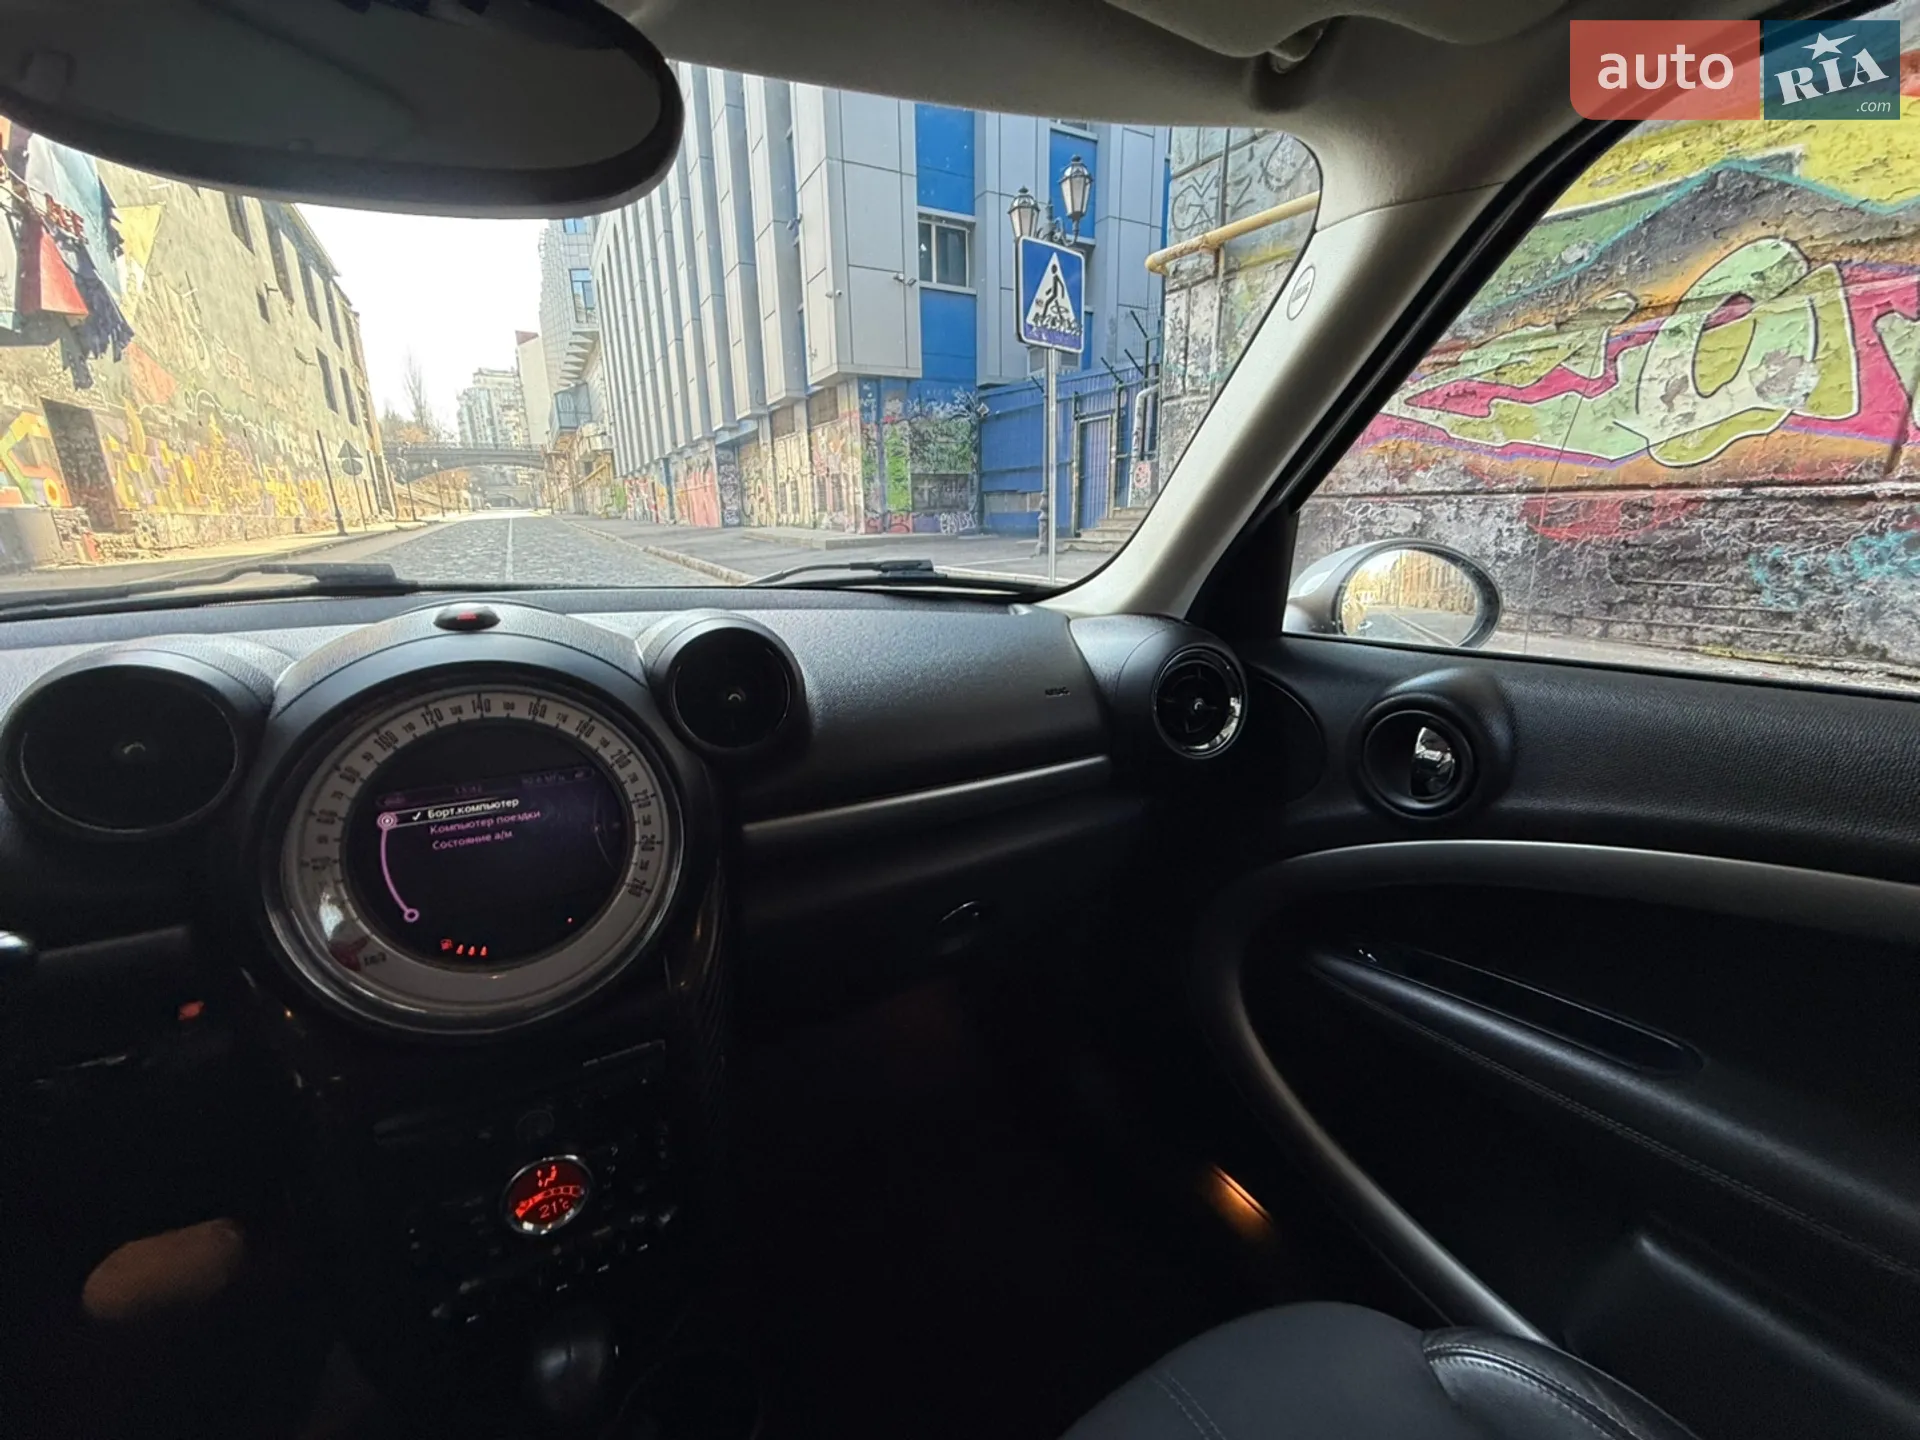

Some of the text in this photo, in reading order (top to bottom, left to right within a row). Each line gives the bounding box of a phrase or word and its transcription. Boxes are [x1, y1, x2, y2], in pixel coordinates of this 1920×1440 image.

[471, 698, 491, 713] 140
[528, 701, 547, 718] 160
[421, 708, 444, 726] 120
[430, 810, 541, 835] Компьютер поездки
[431, 833, 492, 851] Состояние
